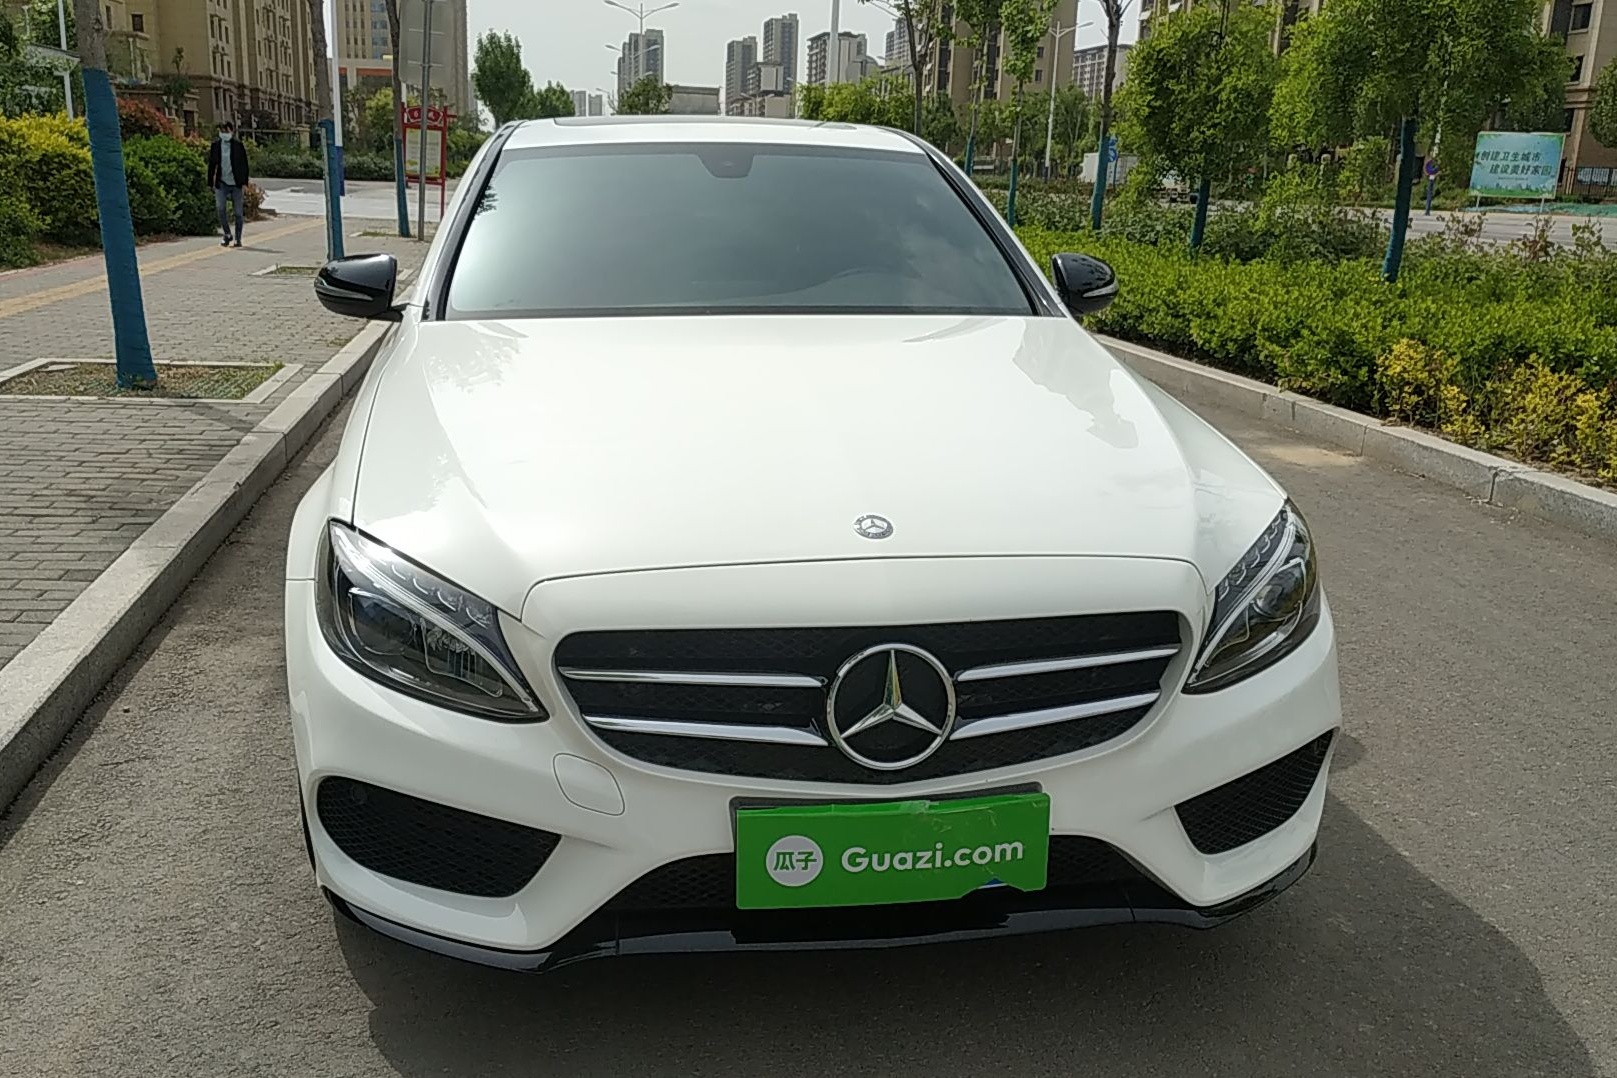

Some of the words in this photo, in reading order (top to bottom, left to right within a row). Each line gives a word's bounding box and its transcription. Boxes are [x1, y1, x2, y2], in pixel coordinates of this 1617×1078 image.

[1480, 150, 1541, 161] 创建卫生城市
[1489, 164, 1552, 176] 建设美好家园
[773, 850, 817, 871] 瓜子
[841, 841, 1023, 872] Guazi.com
